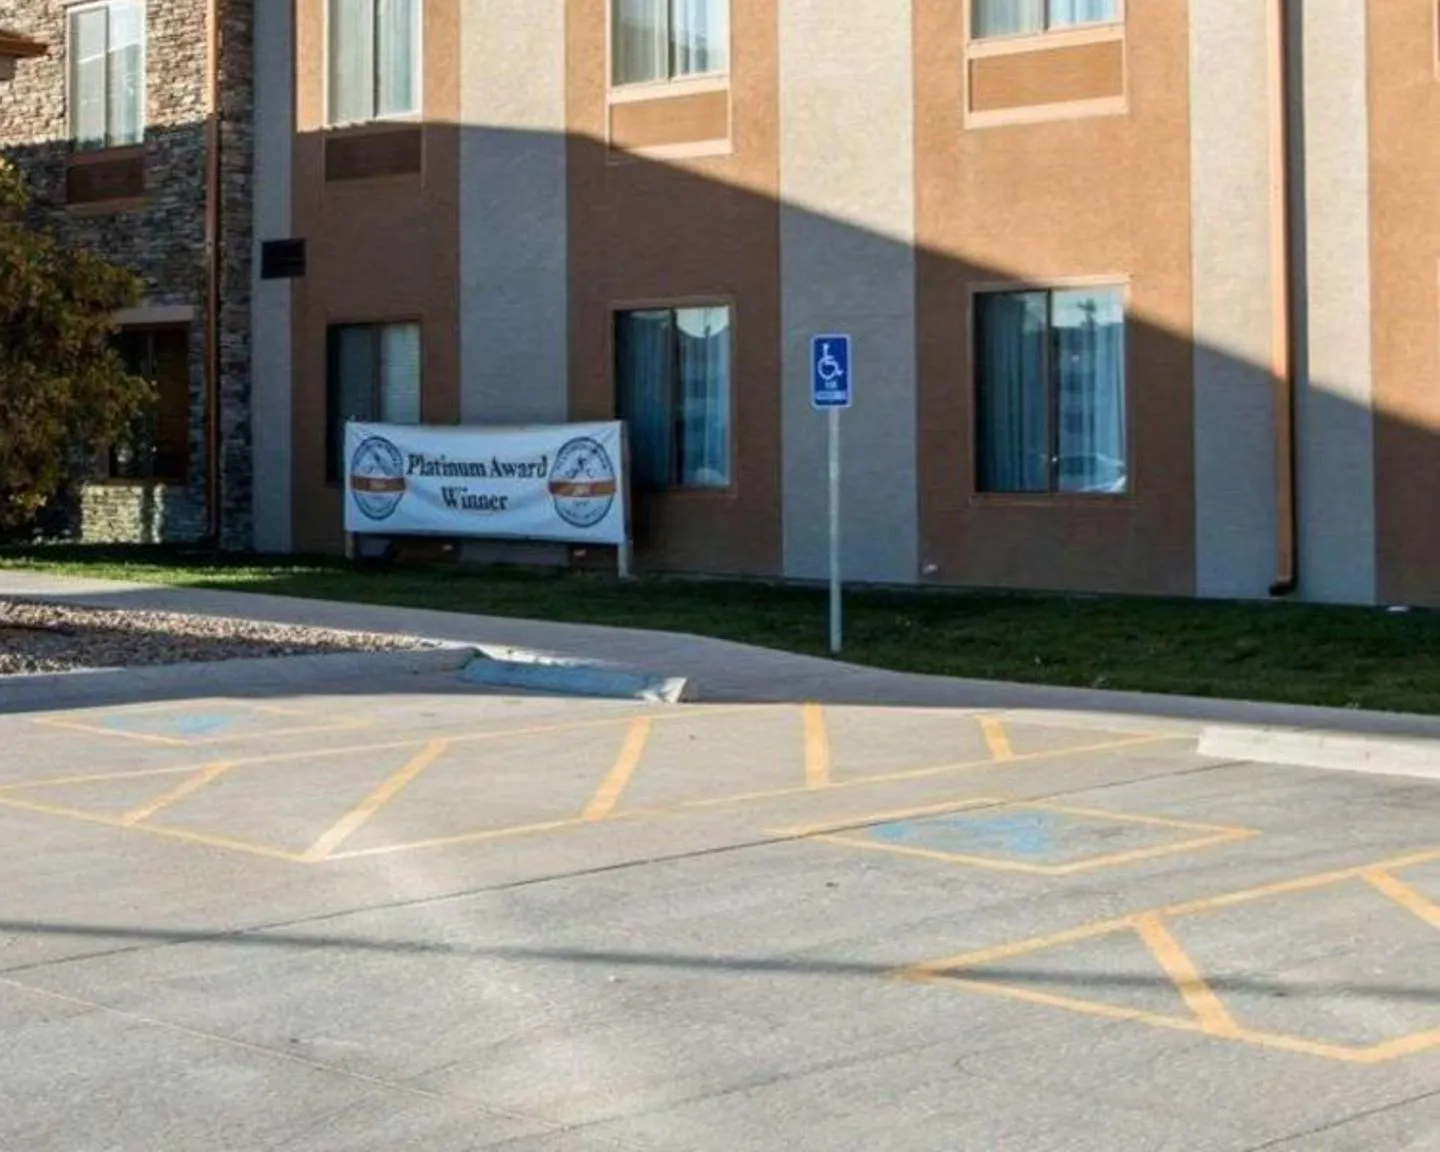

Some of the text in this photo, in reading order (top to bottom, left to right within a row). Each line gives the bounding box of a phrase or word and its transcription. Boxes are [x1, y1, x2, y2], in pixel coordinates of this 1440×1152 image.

[406, 454, 549, 478] Platinum Award
[441, 486, 509, 511] Winner
